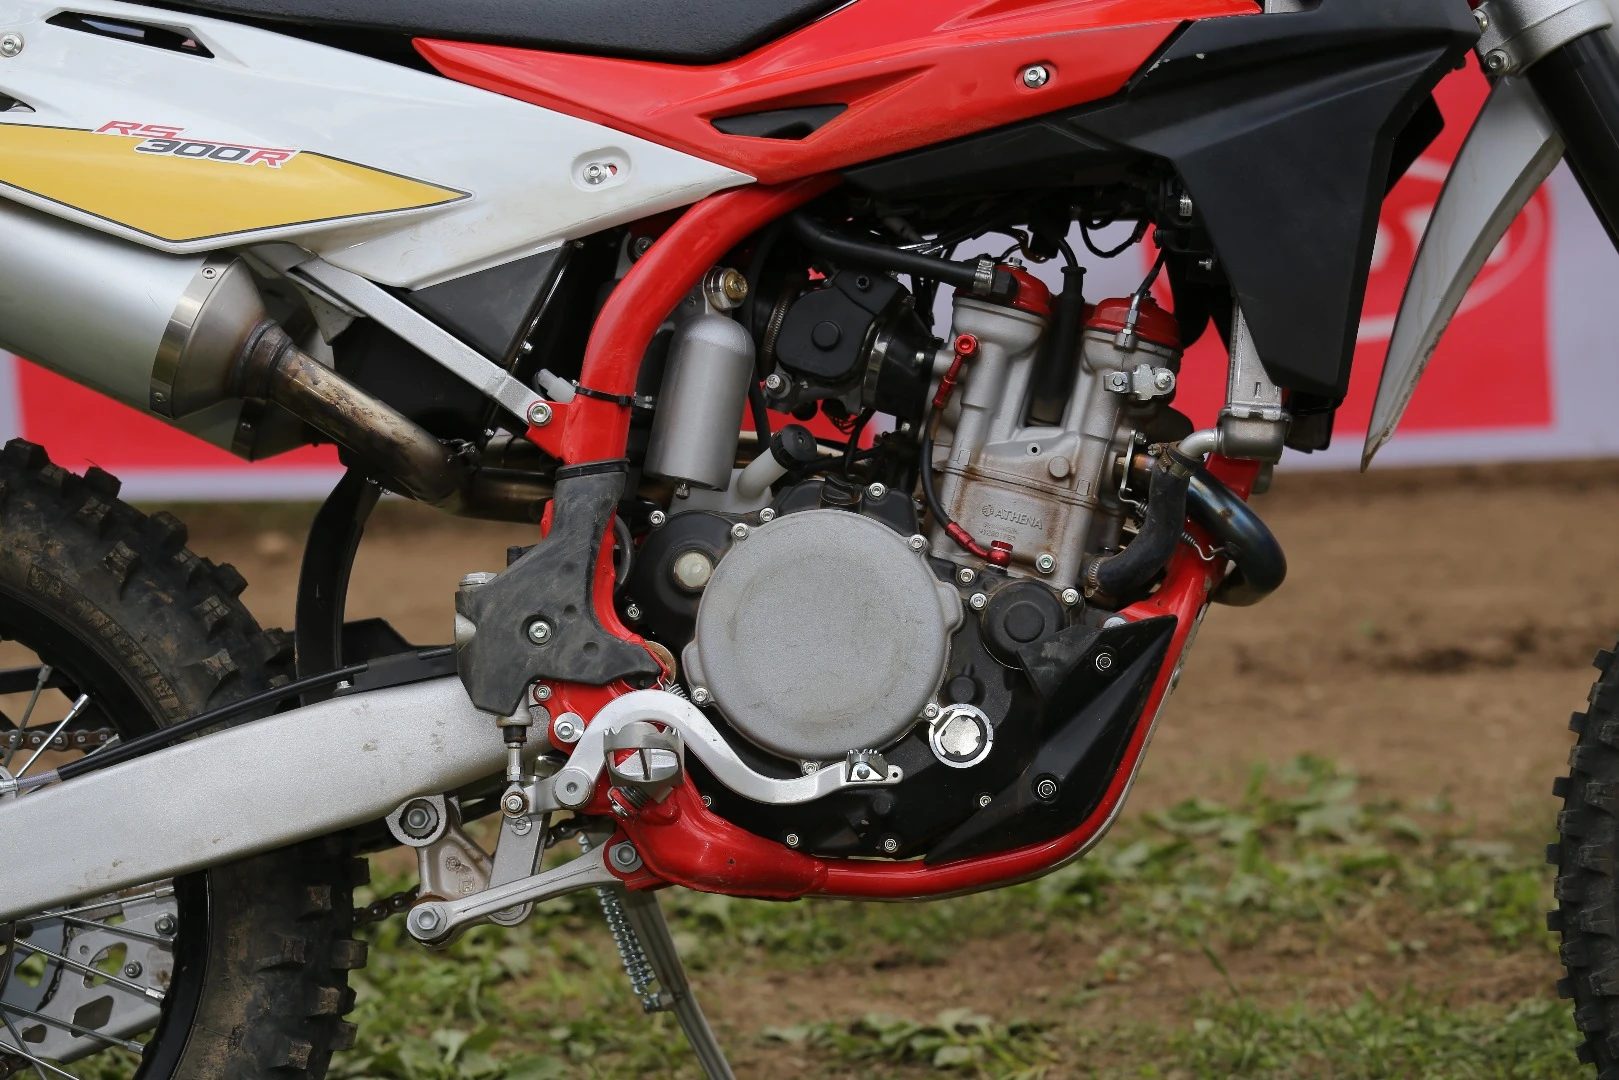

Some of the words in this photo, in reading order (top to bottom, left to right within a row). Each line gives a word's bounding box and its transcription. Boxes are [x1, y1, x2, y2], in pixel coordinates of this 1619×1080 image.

[96, 120, 185, 139] RS
[135, 138, 291, 167] 300R
[994, 508, 1043, 530] ATHENA
